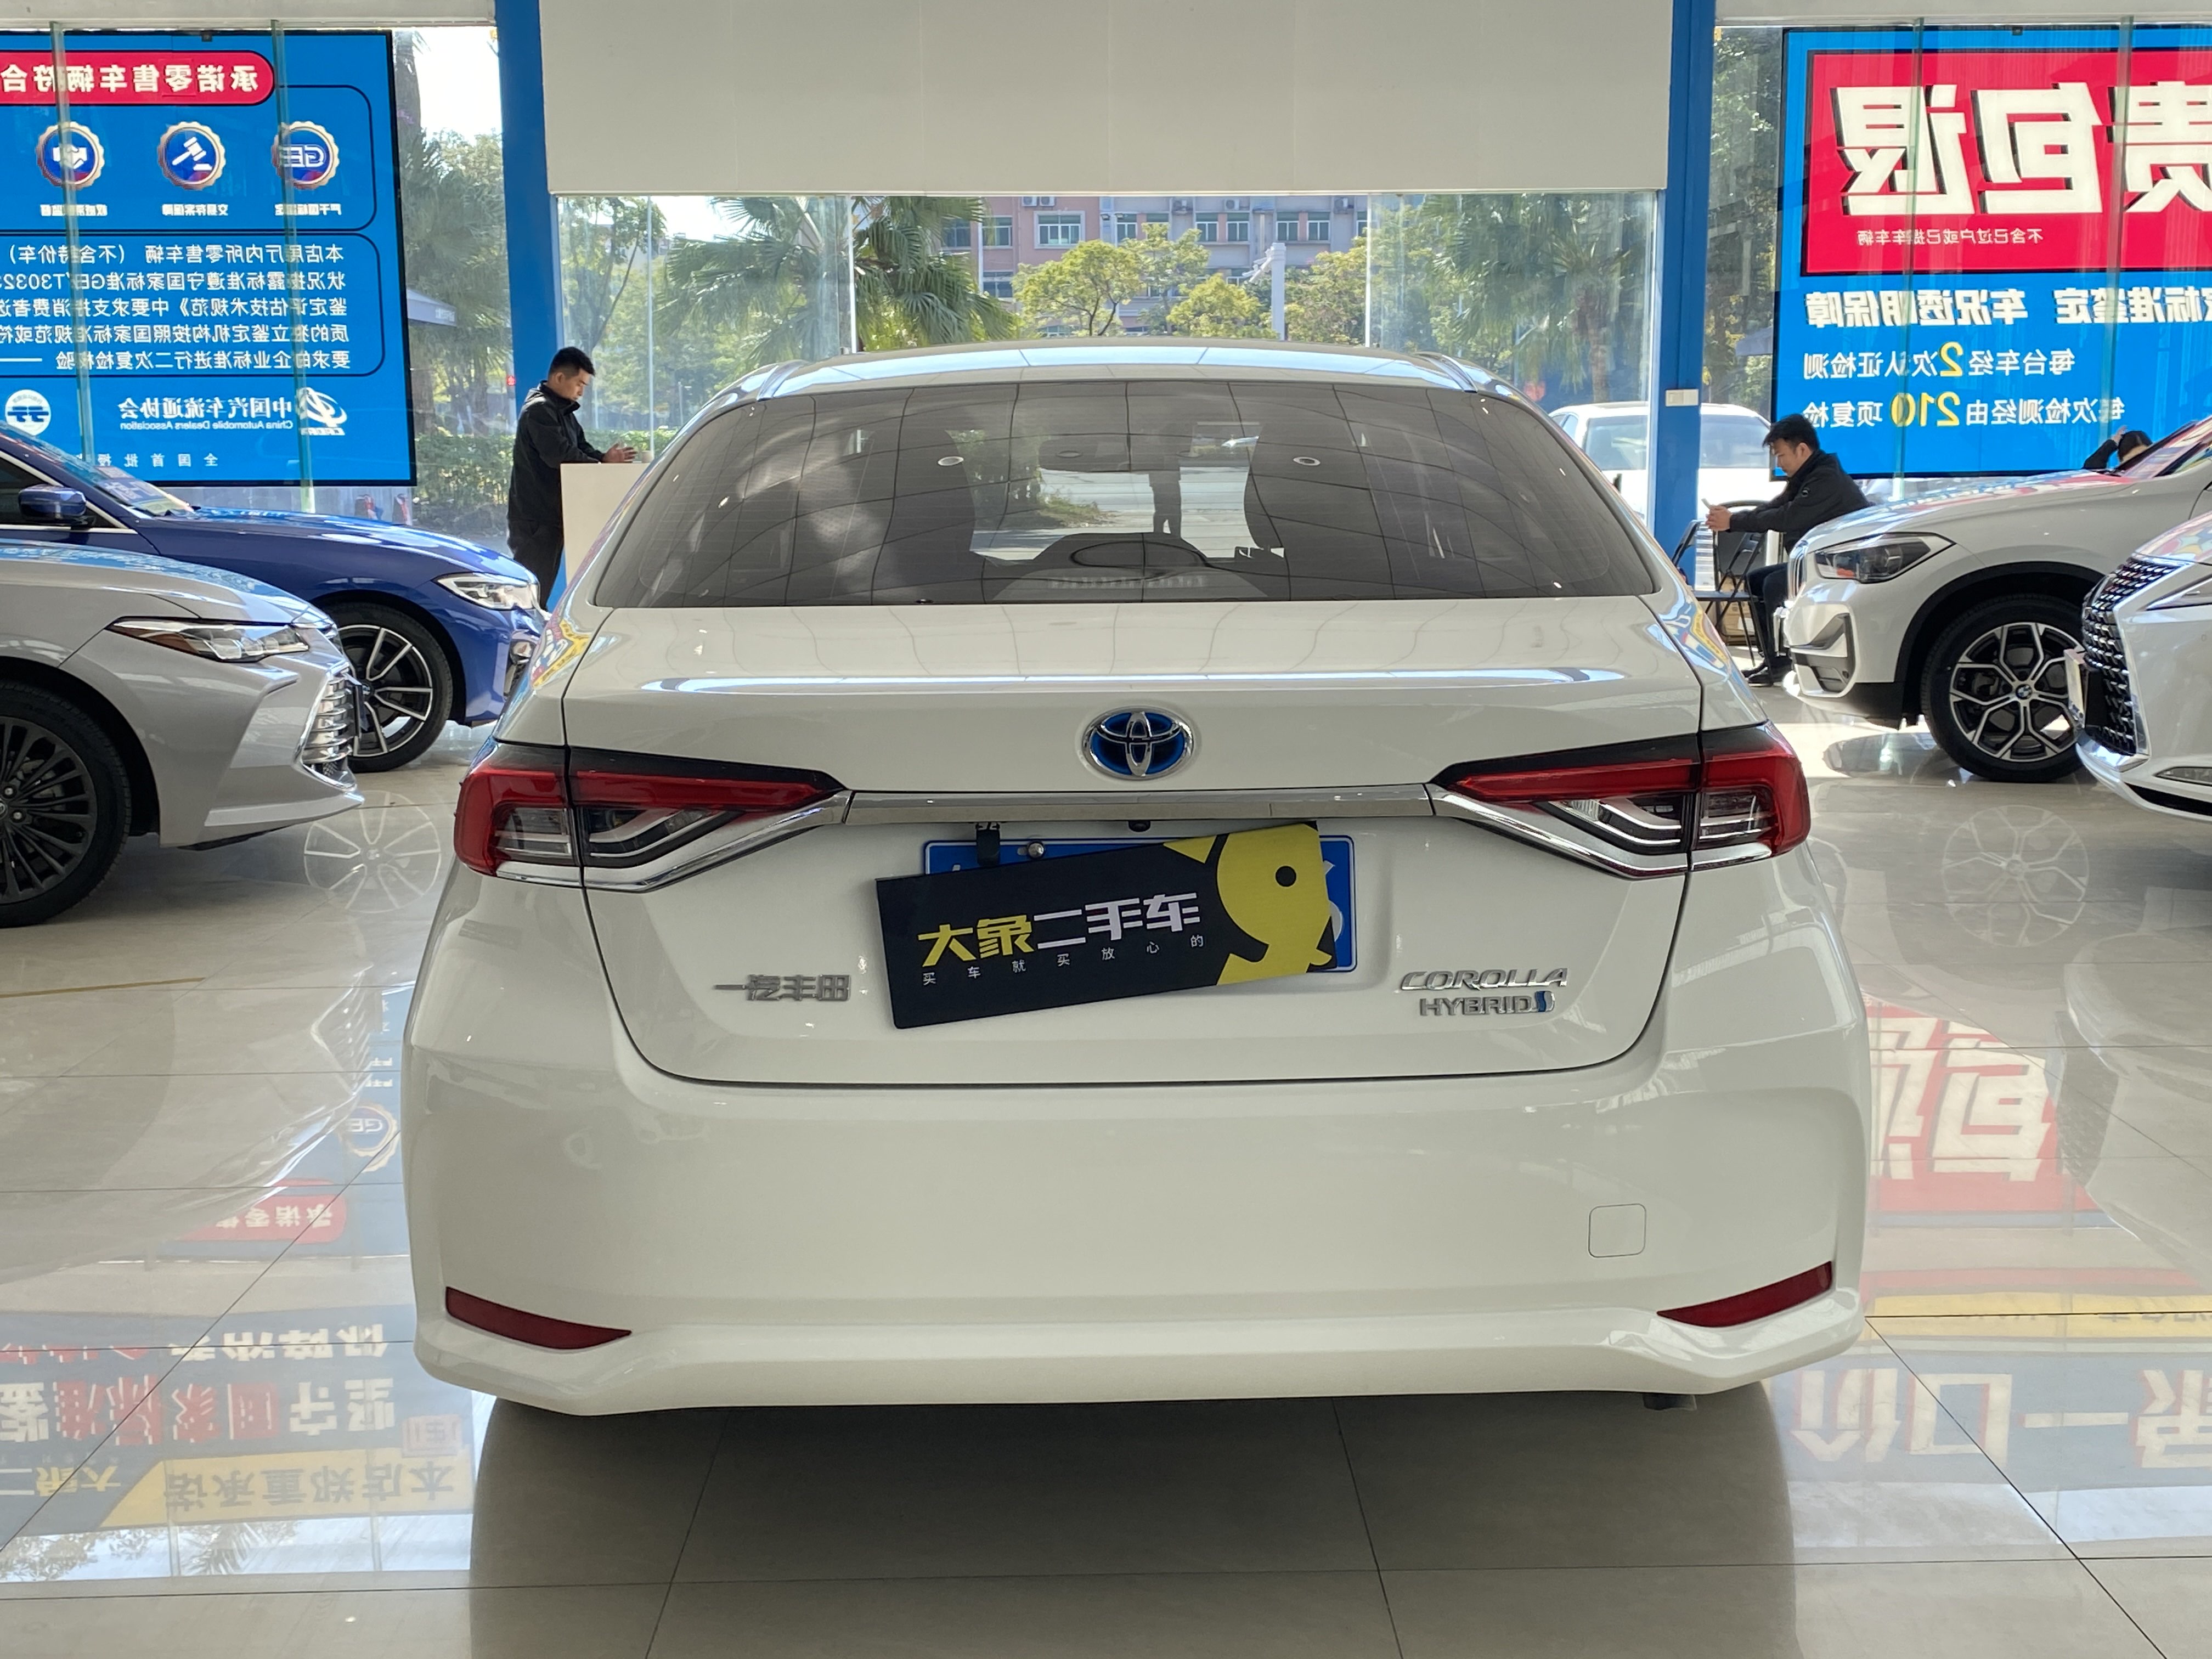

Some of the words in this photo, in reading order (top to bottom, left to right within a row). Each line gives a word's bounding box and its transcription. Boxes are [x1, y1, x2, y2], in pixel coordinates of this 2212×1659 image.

[917, 892, 1201, 967] 大象二手车
[922, 934, 1204, 986] 买车就买放心的
[714, 974, 851, 1001] 一汽丰田
[1401, 968, 1568, 991] COROLLA
[1420, 995, 1534, 1015] HYBRID
